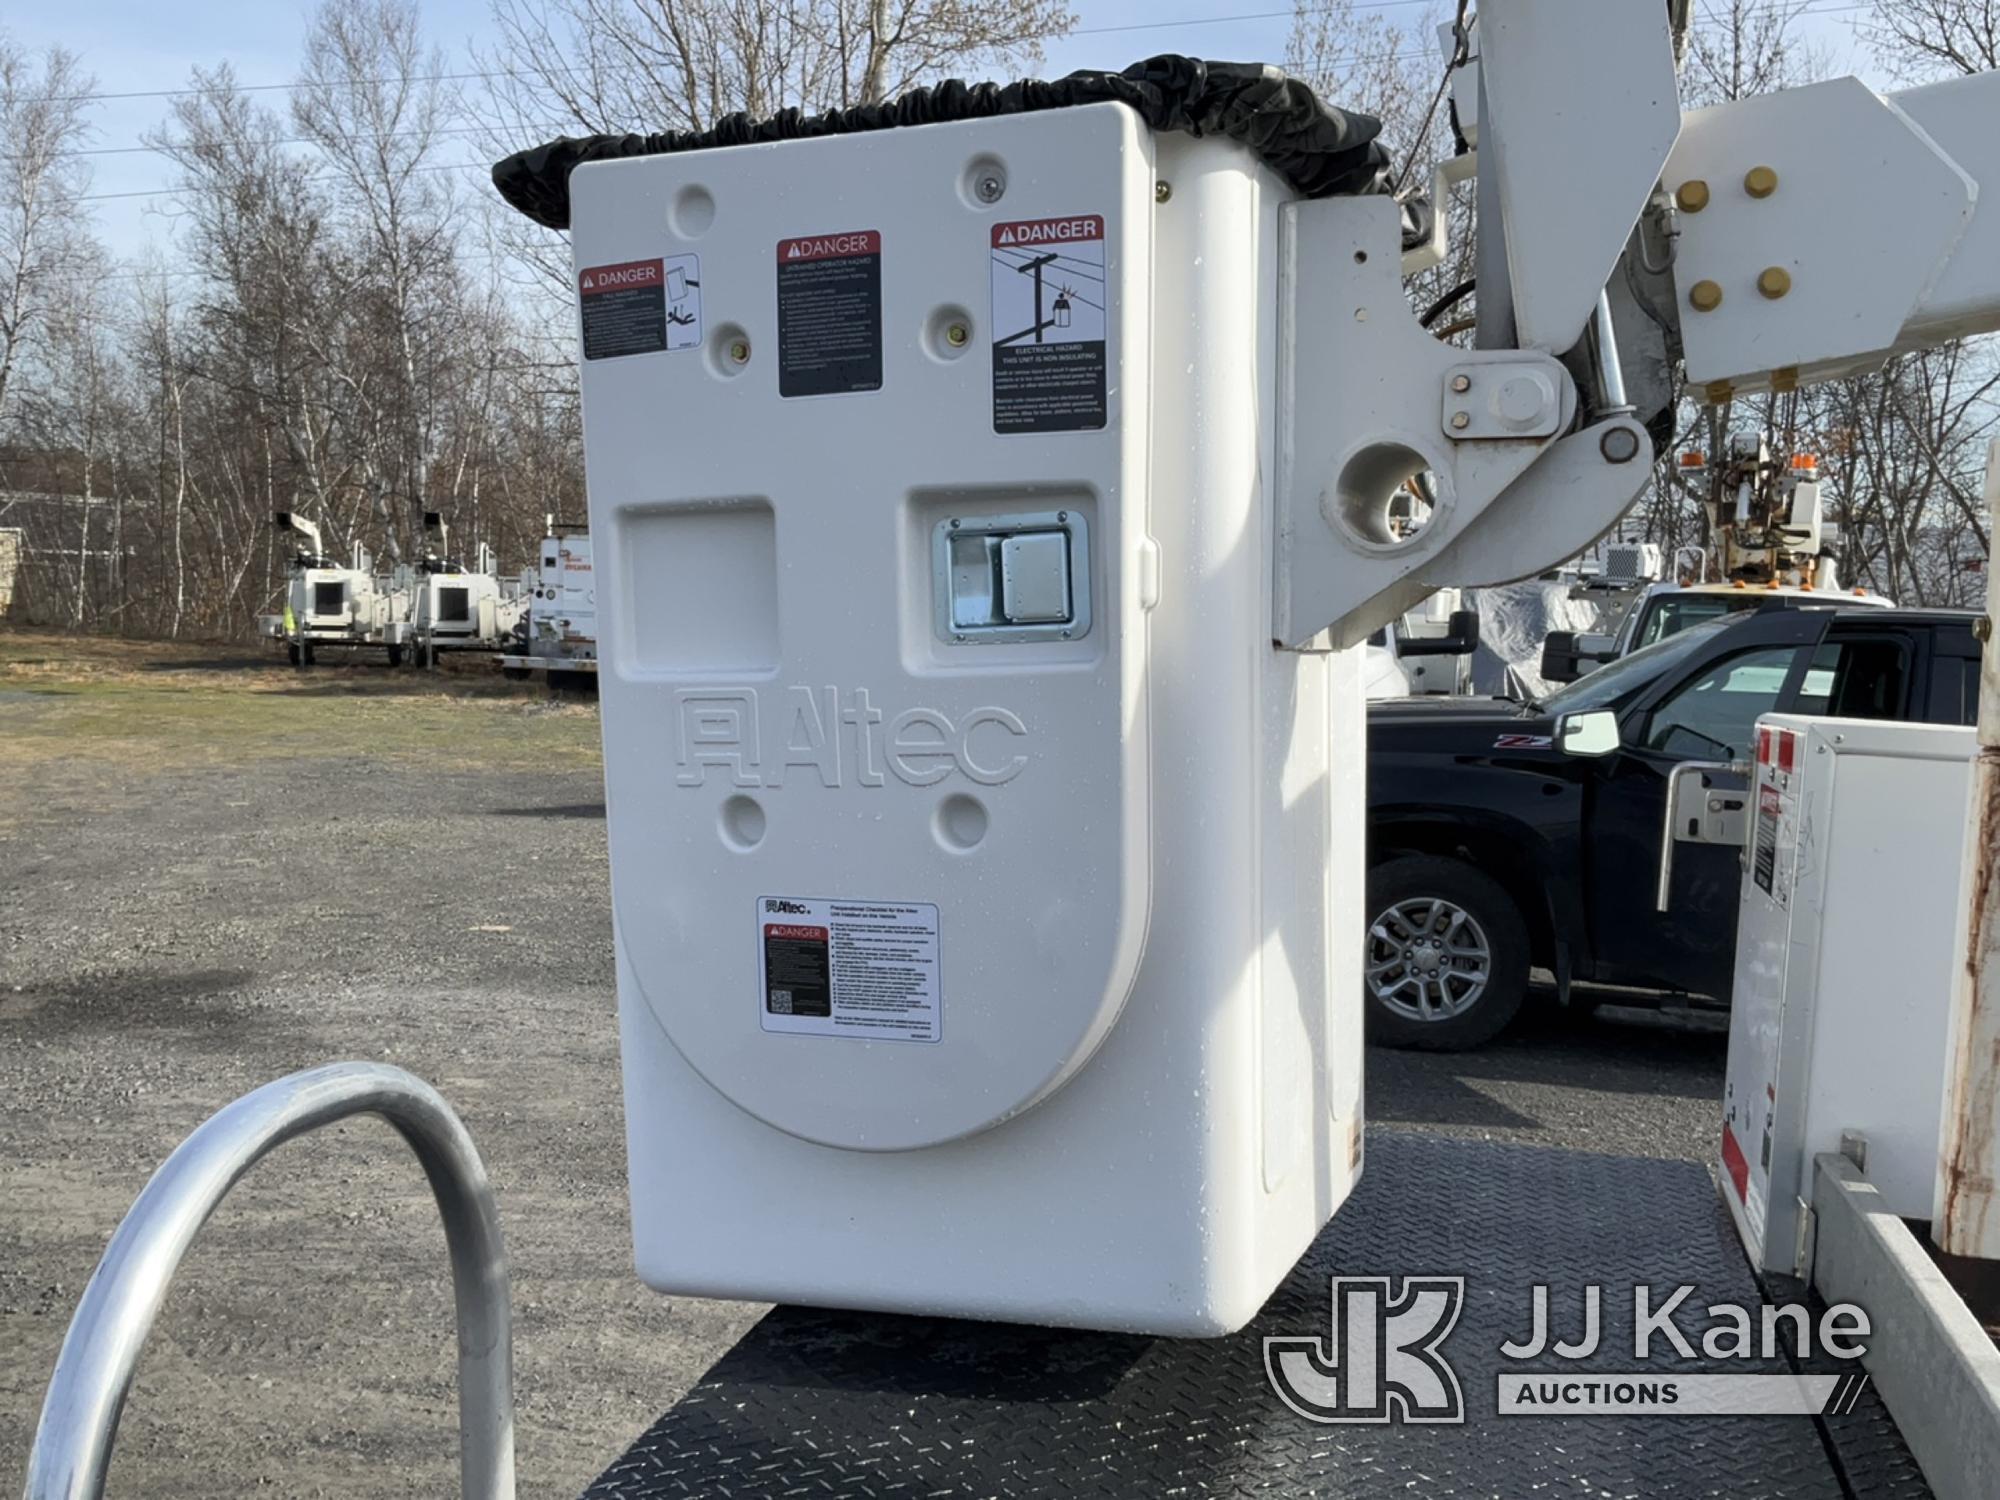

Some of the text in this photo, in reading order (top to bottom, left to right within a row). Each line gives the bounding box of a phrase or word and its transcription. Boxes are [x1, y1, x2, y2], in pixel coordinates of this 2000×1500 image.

[1017, 220, 1096, 242] DANGER
[800, 235, 868, 257] DANGER
[598, 266, 656, 286] DANGER
[1015, 344, 1083, 354] ELECTRICAL HAZARD
[1059, 353, 1096, 361] INSULATING
[766, 686, 1028, 788] Altec
[1492, 734, 1553, 750] Z7
[777, 900, 806, 914] Altec
[778, 926, 821, 938] DANGER
